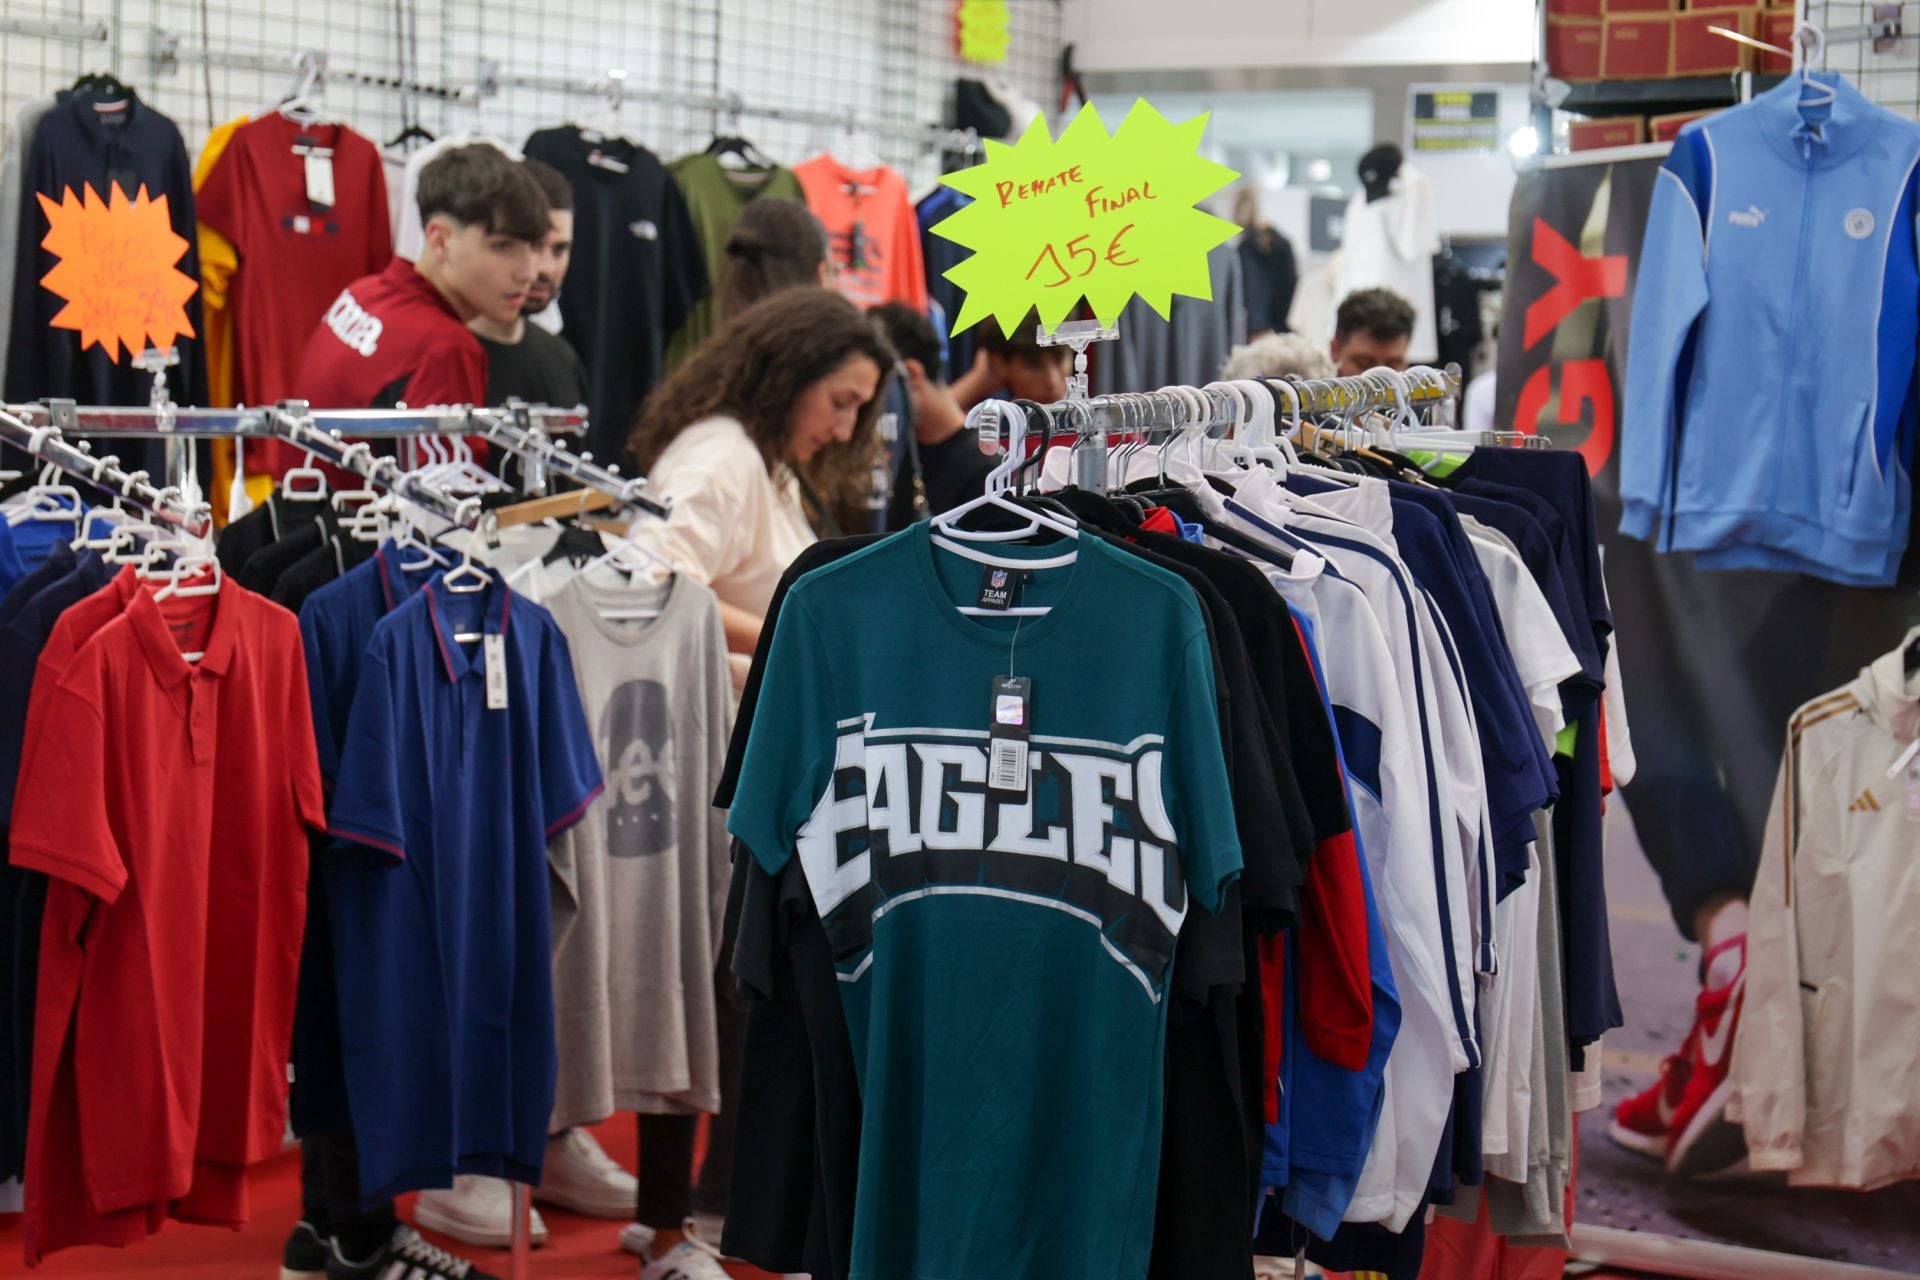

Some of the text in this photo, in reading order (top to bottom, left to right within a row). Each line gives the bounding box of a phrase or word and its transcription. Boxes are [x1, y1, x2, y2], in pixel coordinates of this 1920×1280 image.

[996, 164, 1158, 218] REMATE FINAL
[1024, 223, 1140, 288] 15€
[981, 596, 1005, 605] APPAREL
[983, 589, 1007, 600] TEAM
[796, 731, 1189, 937] EAGLES
